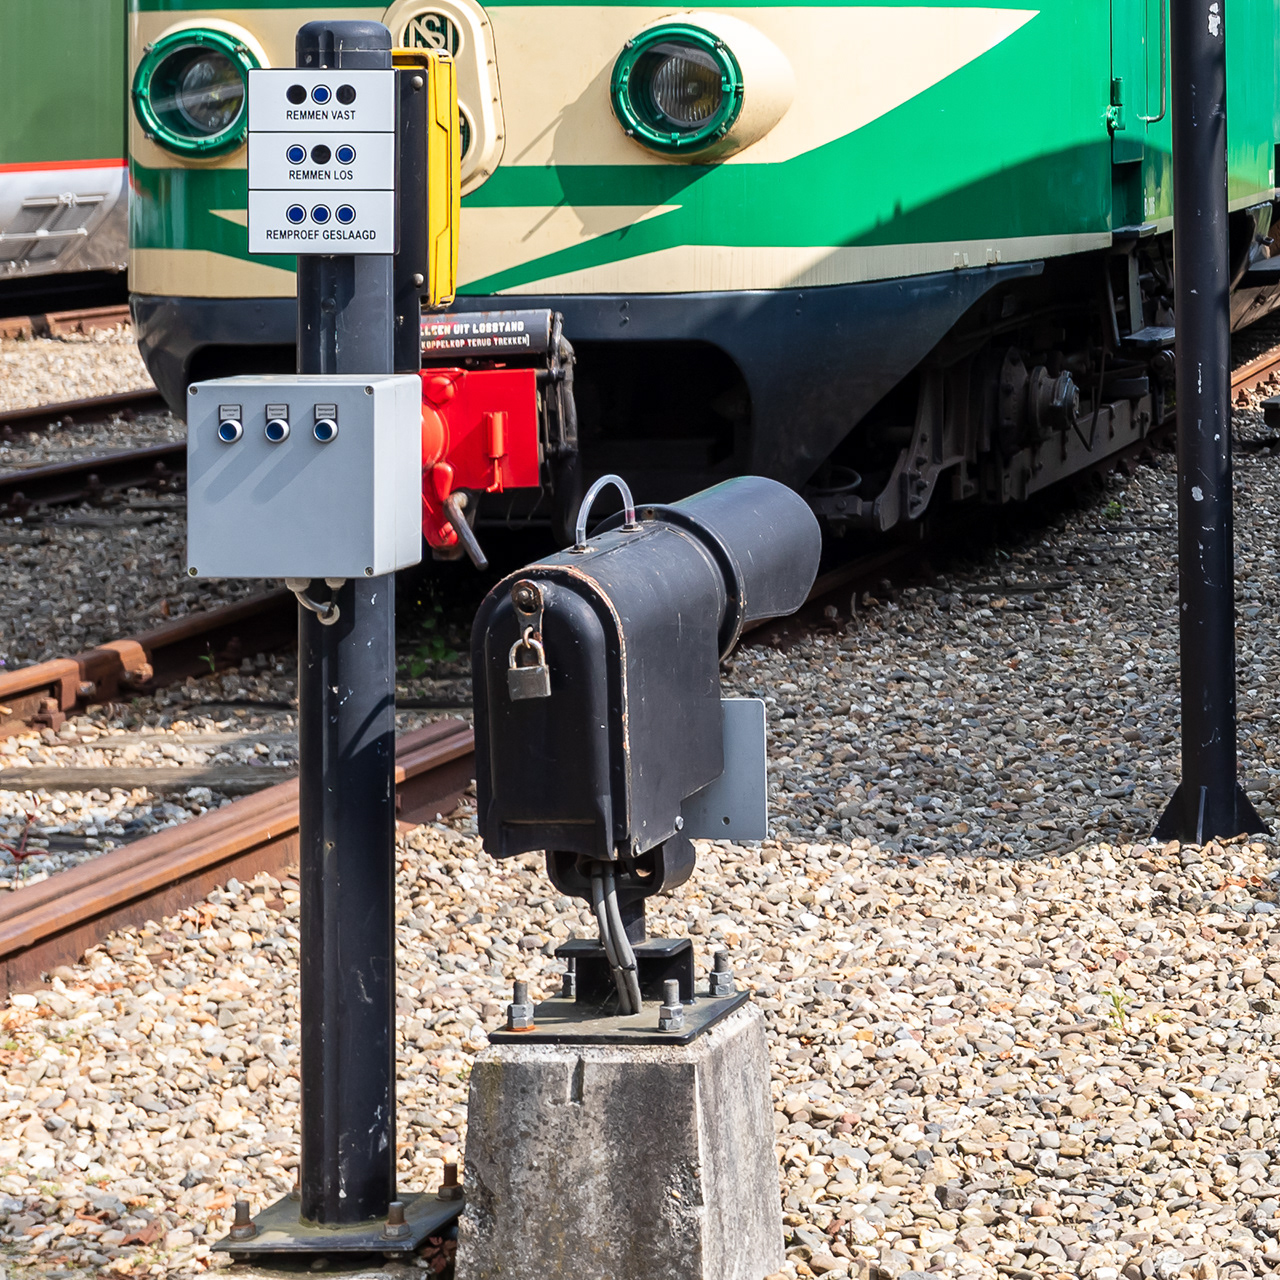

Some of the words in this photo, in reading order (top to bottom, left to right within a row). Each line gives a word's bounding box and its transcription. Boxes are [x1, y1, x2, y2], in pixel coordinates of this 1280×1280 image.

[286, 110, 329, 121] REMMEN
[331, 110, 356, 121] VAST
[288, 170, 331, 180] REMMEN
[333, 170, 354, 181] LOS
[266, 229, 320, 240] REMPROEF
[322, 229, 377, 240] GESLAAGD
[420, 324, 451, 336] LLEEN
[453, 323, 470, 335] UIT
[472, 320, 525, 334] LOSSTAND
[420, 338, 466, 353] KOPPELKOP
[467, 337, 492, 348] TERUG
